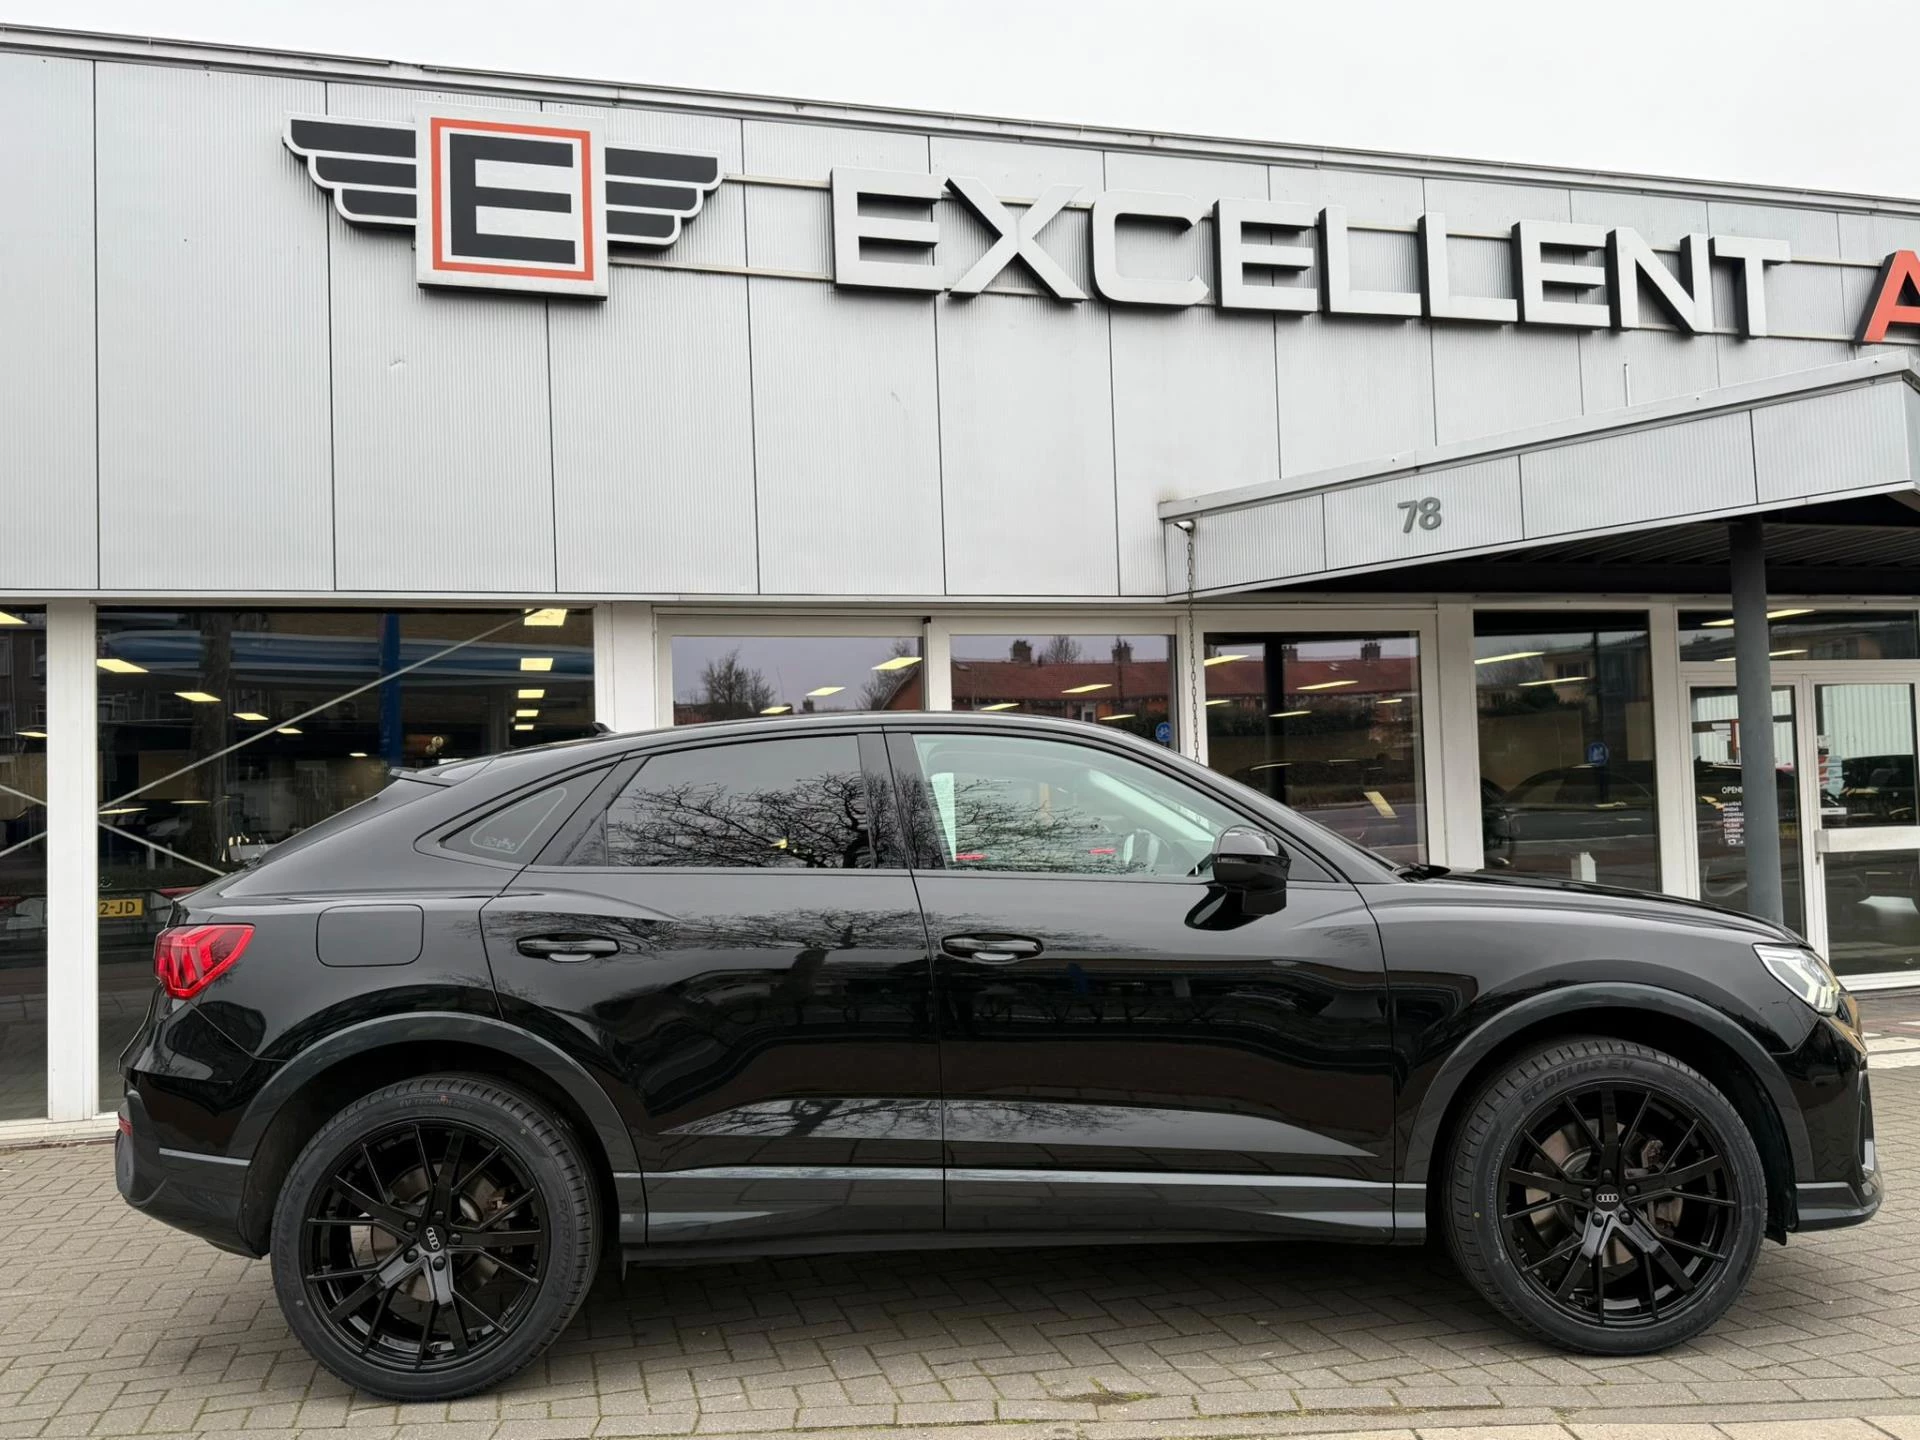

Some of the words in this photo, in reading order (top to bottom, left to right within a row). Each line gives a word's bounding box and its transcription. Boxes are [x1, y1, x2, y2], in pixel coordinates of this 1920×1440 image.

[449, 132, 576, 265] E
[829, 167, 1792, 339] EXCELLENT
[1855, 248, 1920, 344] A
[1397, 496, 1442, 534] 78
